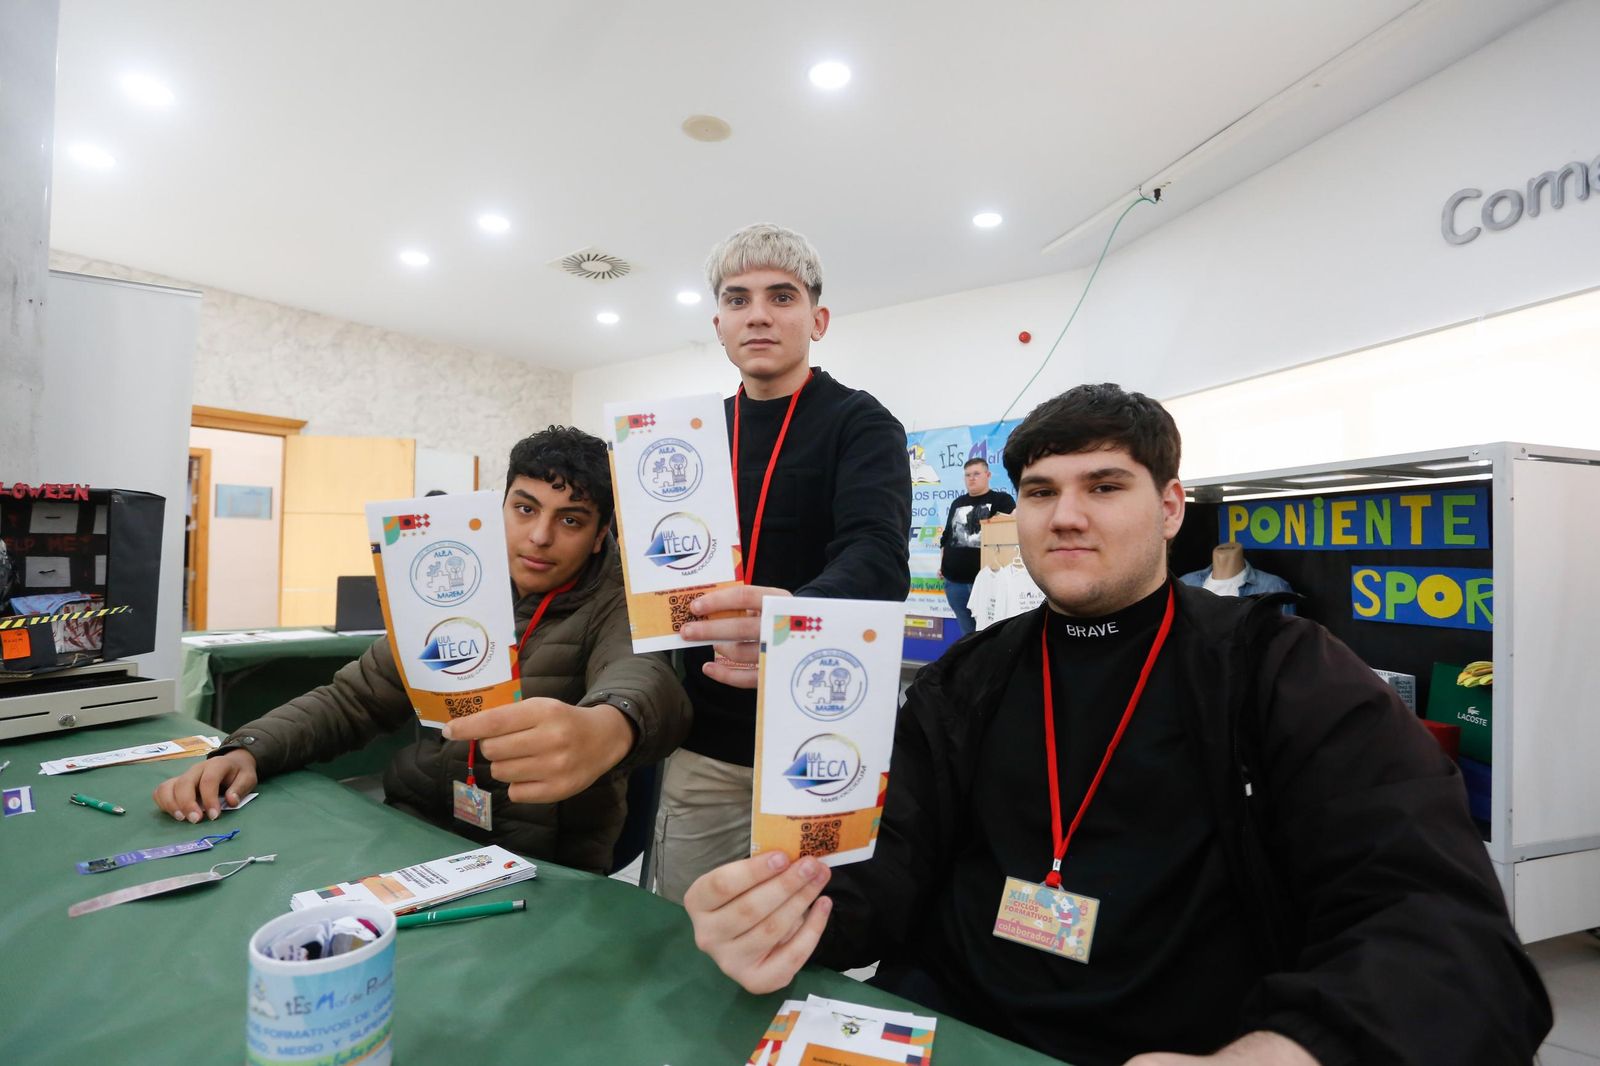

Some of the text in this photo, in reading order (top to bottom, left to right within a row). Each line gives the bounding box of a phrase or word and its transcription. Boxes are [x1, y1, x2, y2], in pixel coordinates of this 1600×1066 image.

[1066, 622, 1119, 638] BRAVE
[1457, 712, 1488, 726] LACOSTE
[1004, 905, 1053, 923] FORMATIVOS
